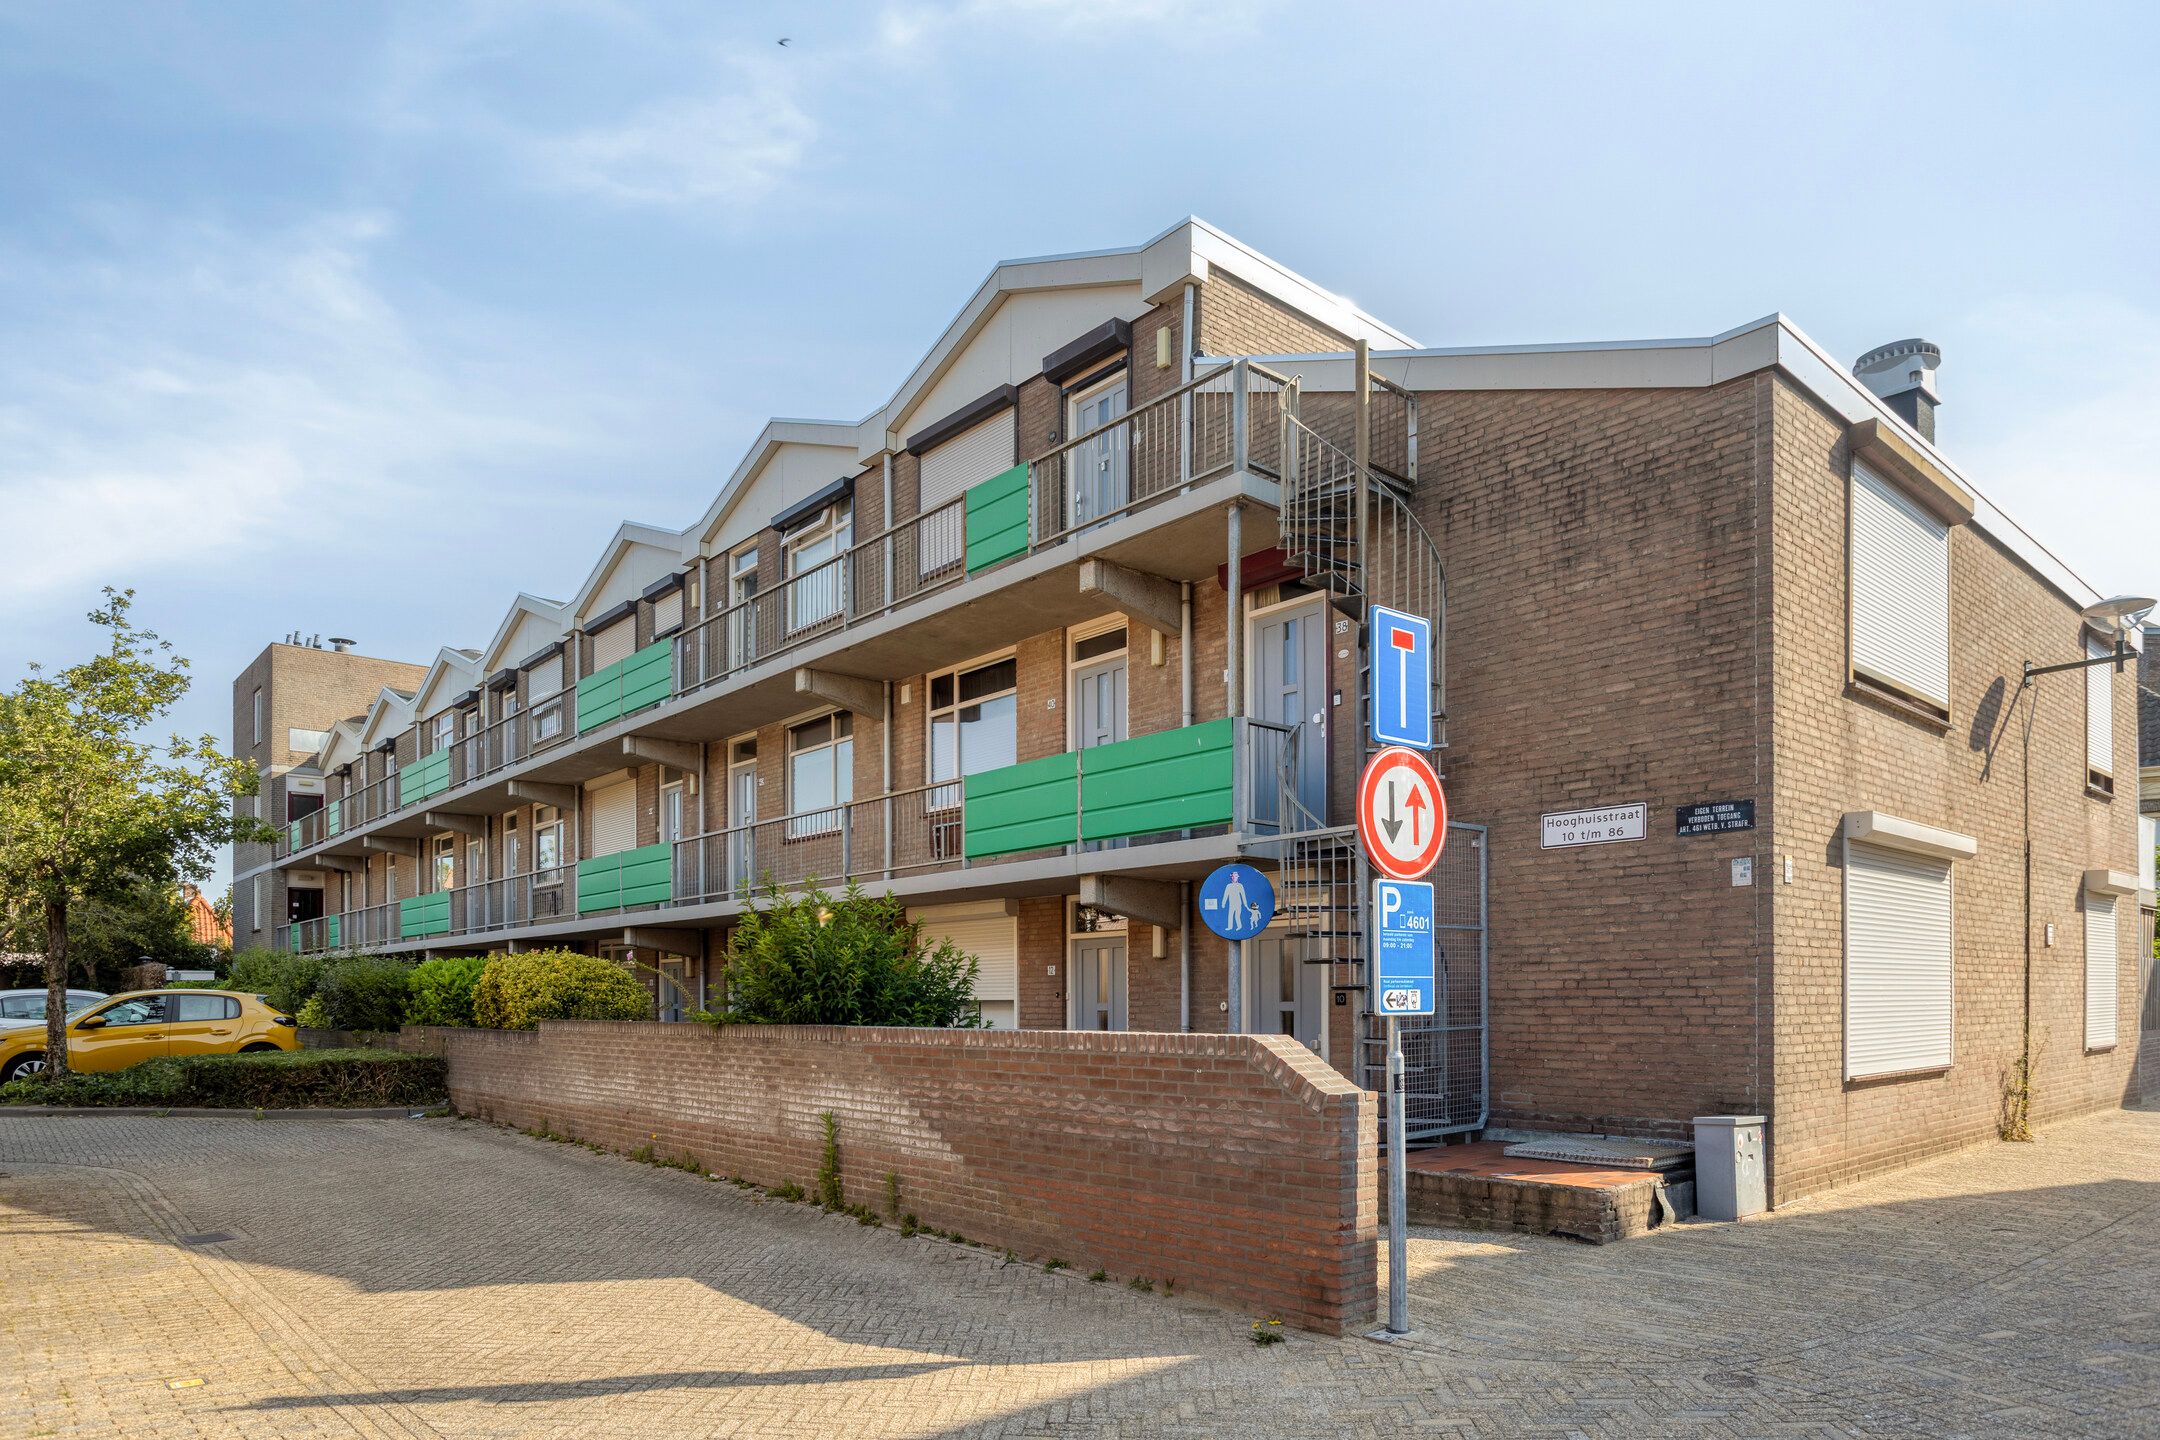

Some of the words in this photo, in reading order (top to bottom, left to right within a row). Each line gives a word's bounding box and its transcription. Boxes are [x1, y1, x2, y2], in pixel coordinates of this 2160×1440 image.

[1336, 622, 1347, 634] 38
[1695, 807, 1710, 815] EIGEN
[1712, 804, 1735, 813] TERREIN
[1547, 809, 1640, 828] Hooghuisstraat
[1688, 815, 1715, 824] VERBODEN
[1717, 812, 1741, 821] TOEGANG
[1692, 824, 1702, 832] 461
[1562, 832, 1575, 842] 10
[1581, 830, 1601, 840] t/m
[1608, 827, 1624, 837] 86
[1382, 886, 1402, 928] P
[1407, 915, 1430, 930] 4601
[1336, 995, 1344, 1003] 10
